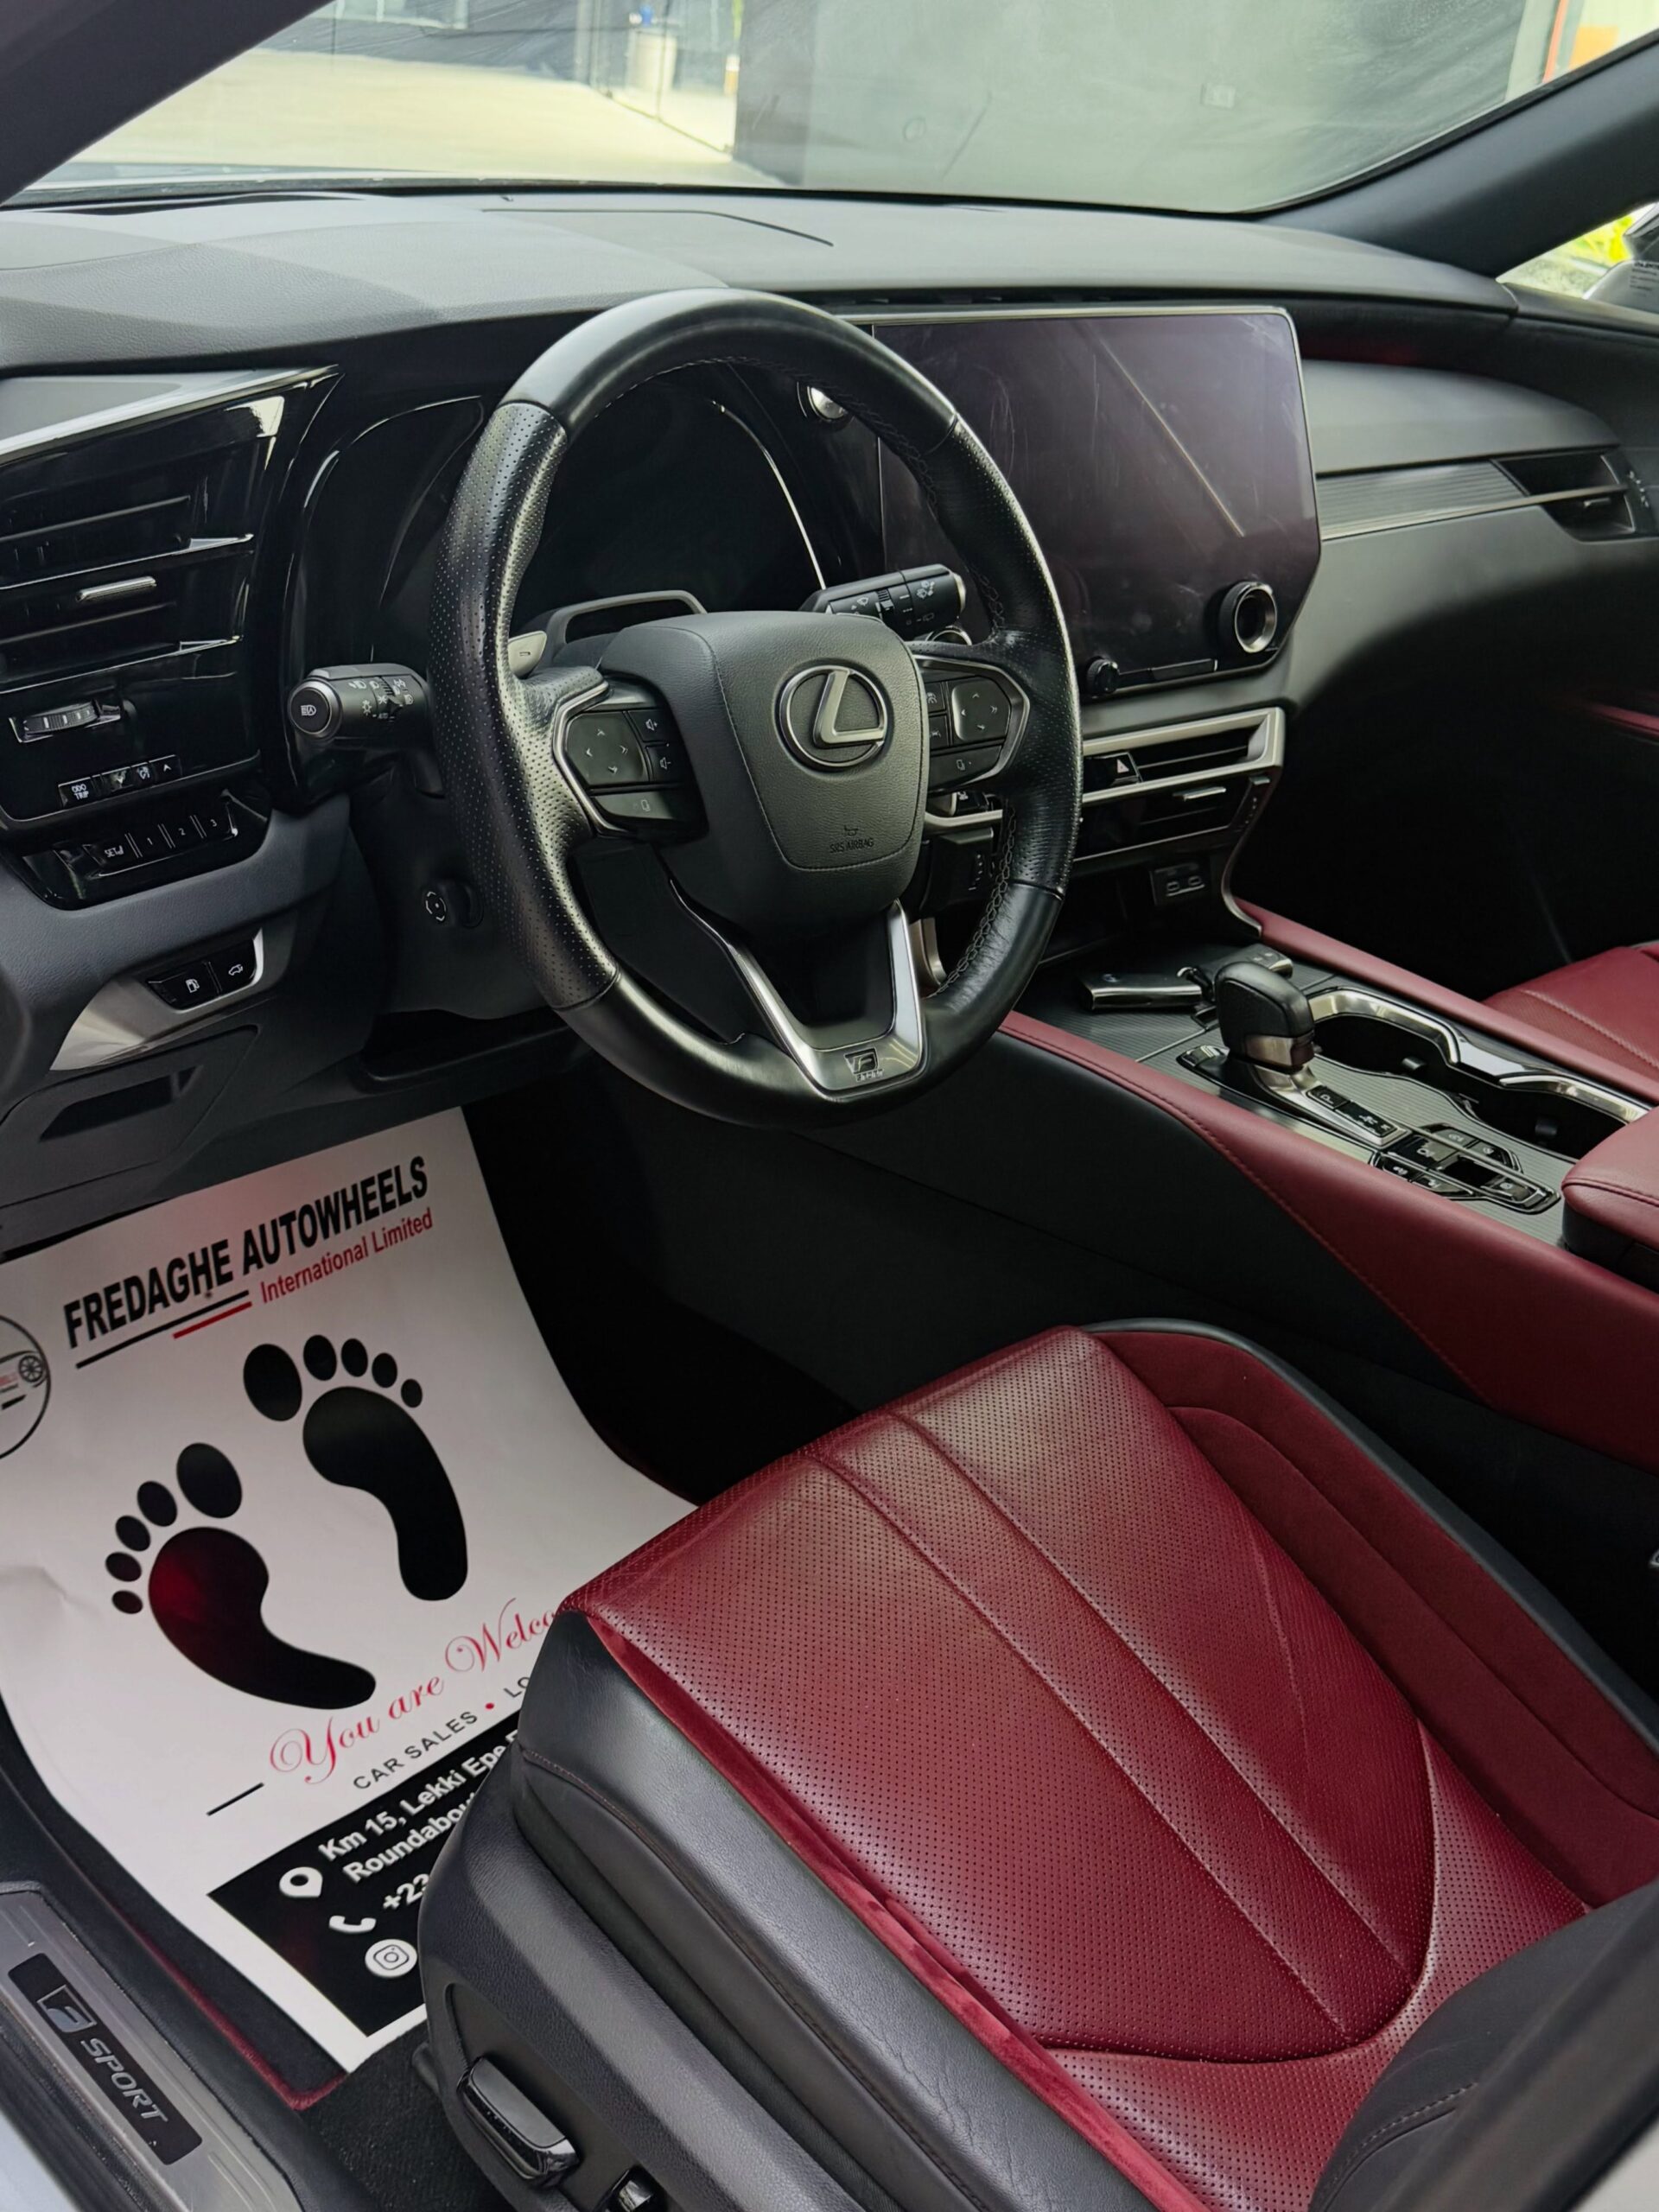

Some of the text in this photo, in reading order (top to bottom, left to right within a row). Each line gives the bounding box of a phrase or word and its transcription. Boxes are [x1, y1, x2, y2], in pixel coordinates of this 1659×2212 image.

[63, 1155, 428, 1350] FREDAGHE AUTOWHEELS
[260, 1207, 433, 1303] International Limited
[270, 1715, 380, 1784] You
[388, 1676, 444, 1719] are
[353, 1749, 404, 1789] CAR
[404, 1711, 478, 1759] SALES
[318, 1831, 367, 1861] Km
[365, 1811, 407, 1835] 15,
[400, 1769, 467, 1815] Lekki
[342, 1791, 475, 1883] Roundabo
[80, 2037, 168, 2123] SPORT
